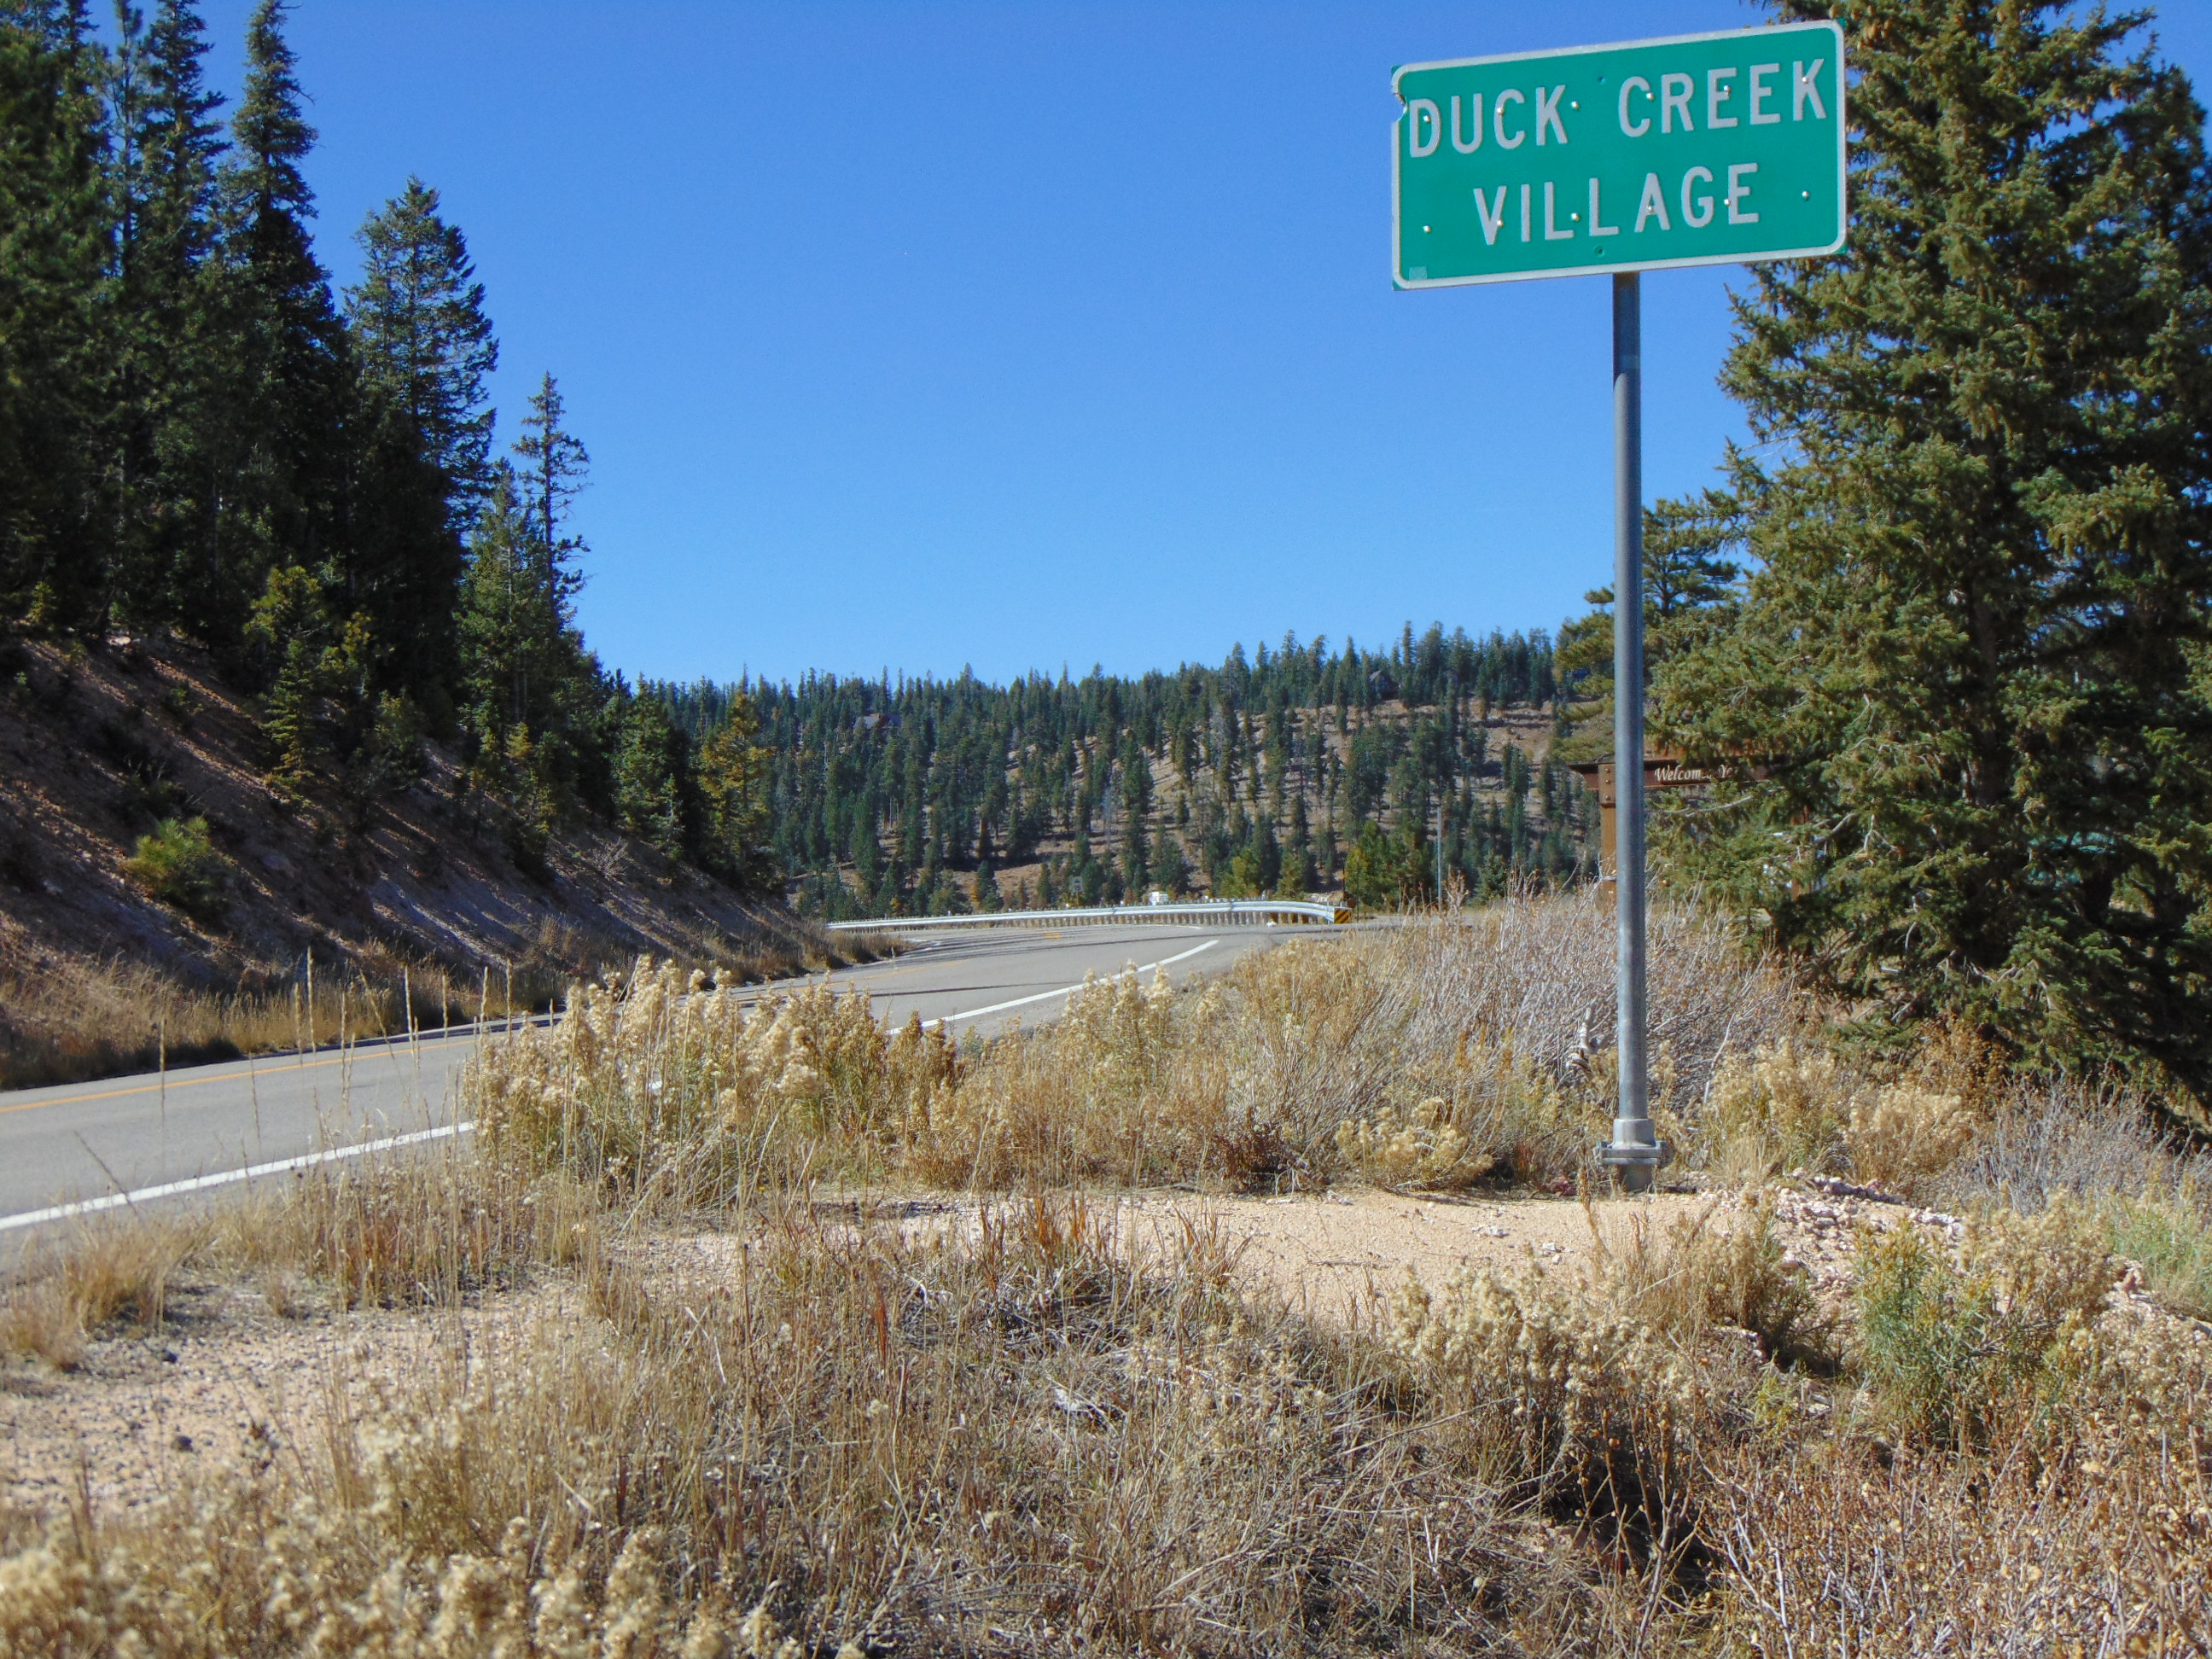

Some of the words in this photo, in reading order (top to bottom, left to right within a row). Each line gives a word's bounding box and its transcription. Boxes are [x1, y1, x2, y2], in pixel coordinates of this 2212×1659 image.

[1410, 85, 1568, 158] DUCK
[1620, 59, 1826, 137] CREEK
[1475, 164, 1759, 245] VILLAGE
